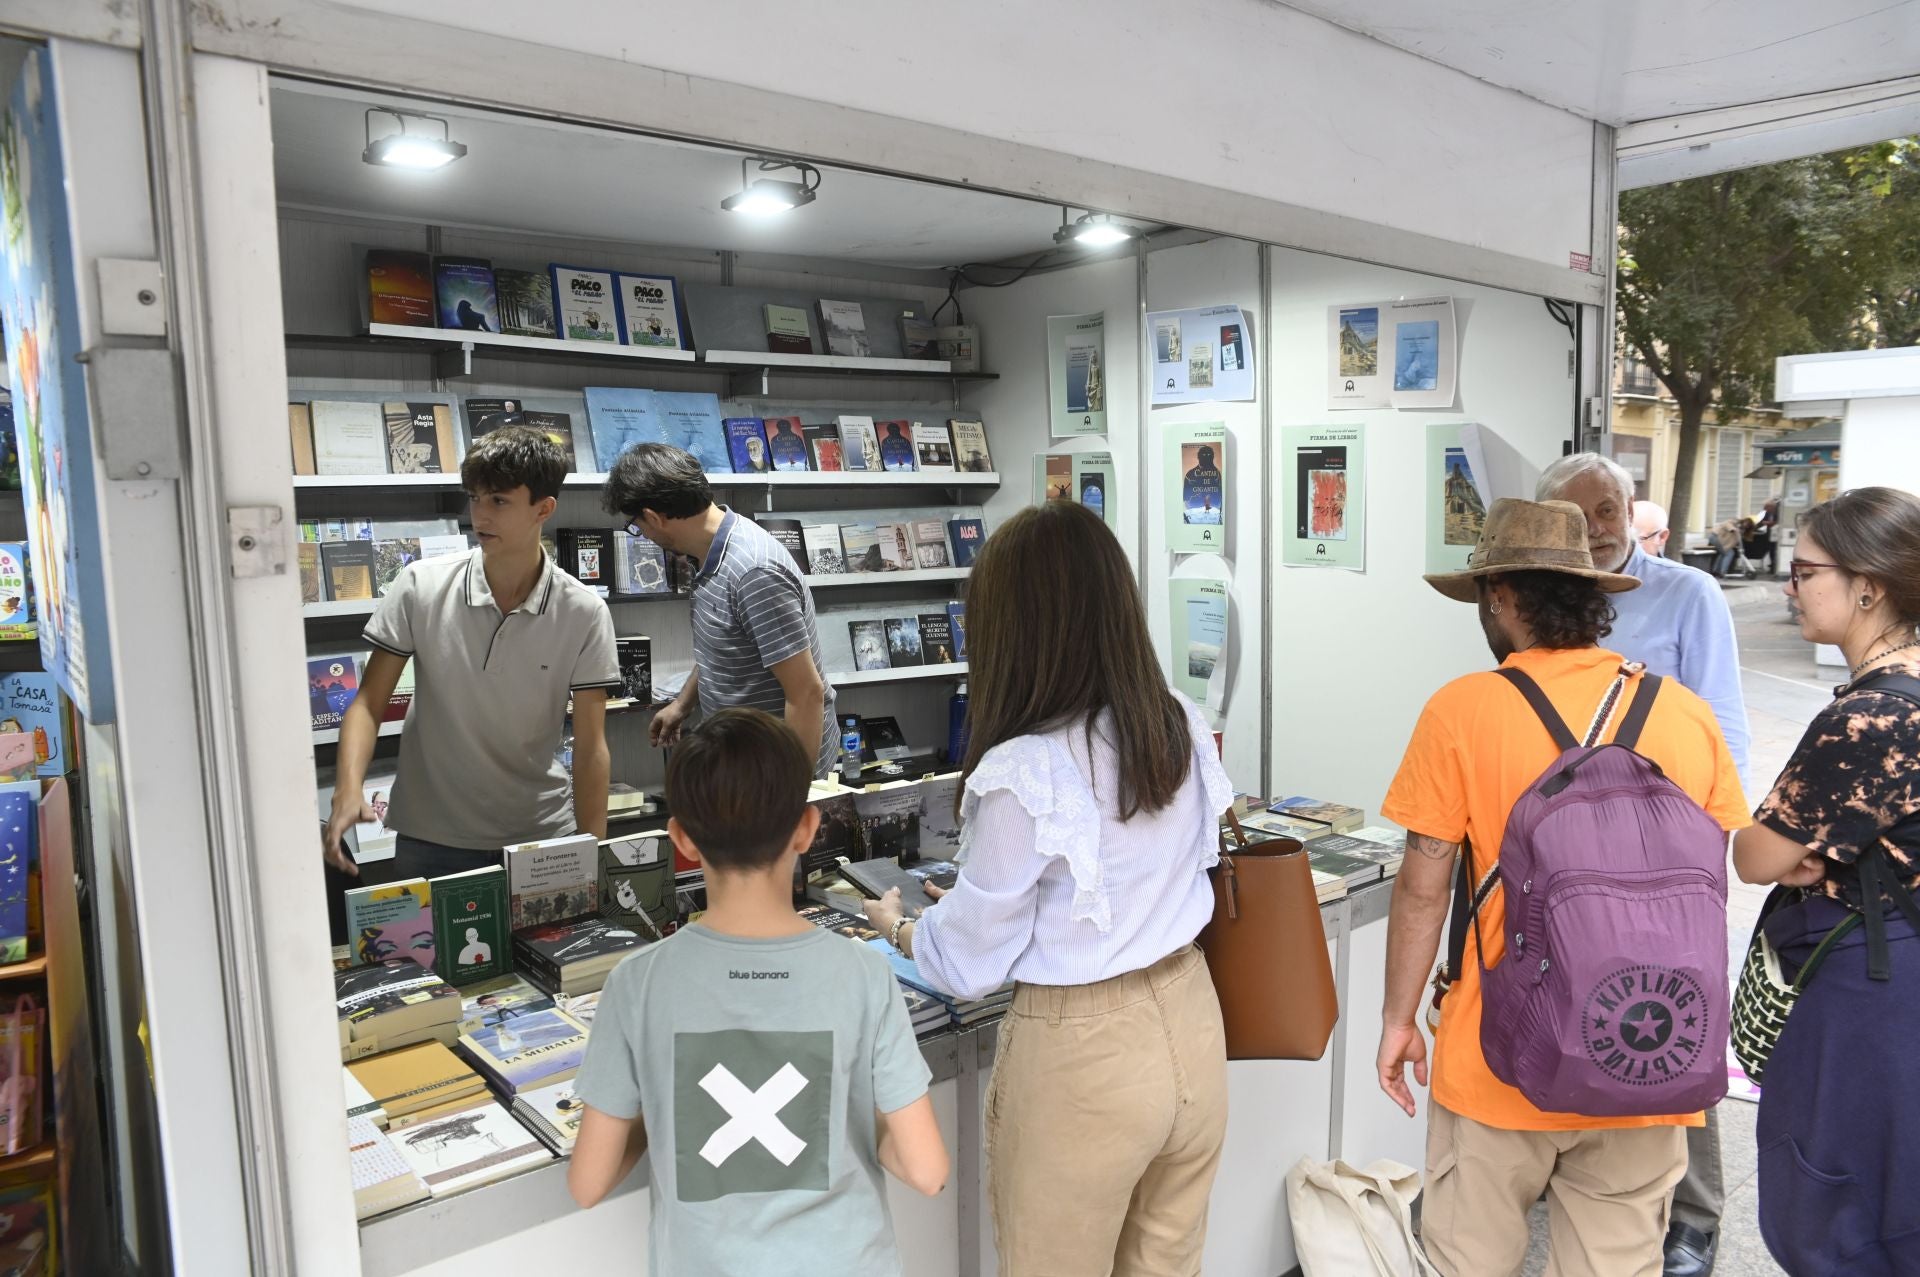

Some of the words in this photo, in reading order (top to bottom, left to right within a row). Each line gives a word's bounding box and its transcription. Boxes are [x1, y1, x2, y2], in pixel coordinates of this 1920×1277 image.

[571, 279, 602, 292] PACO
[634, 286, 664, 298] PACO
[414, 420, 434, 428] Regia
[1194, 469, 1217, 477] CANTAR
[2, 566, 16, 574] AL
[11, 678, 21, 686] LA
[16, 687, 47, 701] CASA
[8, 696, 52, 714] Tomasa
[316, 711, 340, 720] ESPEJO
[545, 852, 578, 862] Fronteras
[729, 969, 750, 980] blue
[751, 970, 789, 980] banana
[1595, 972, 1696, 1013] KIPLING
[503, 1056, 522, 1065] LA
[524, 1035, 586, 1057] MURALLA
[1591, 1035, 1697, 1079] KIPLING
